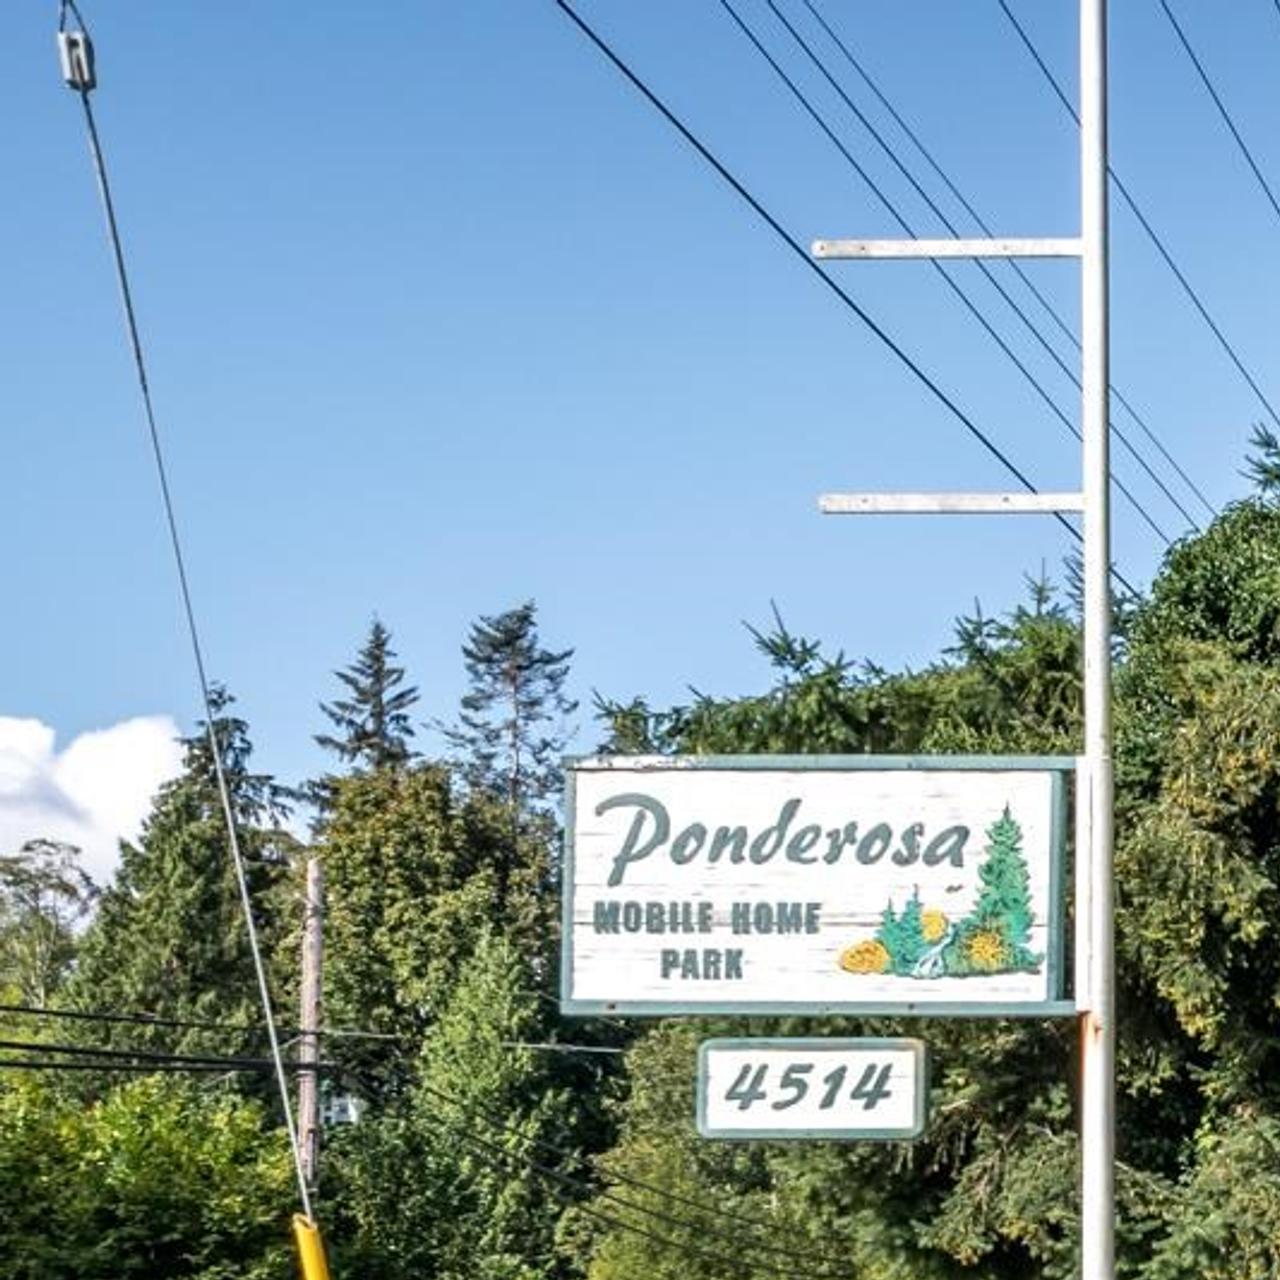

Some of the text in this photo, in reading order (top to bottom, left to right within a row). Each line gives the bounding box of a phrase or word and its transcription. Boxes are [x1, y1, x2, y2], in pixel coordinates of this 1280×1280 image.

[595, 792, 971, 888] Ponderosa
[593, 900, 822, 935] MOBILE HOME
[660, 948, 744, 981] PARK
[724, 1062, 893, 1111] 4514
